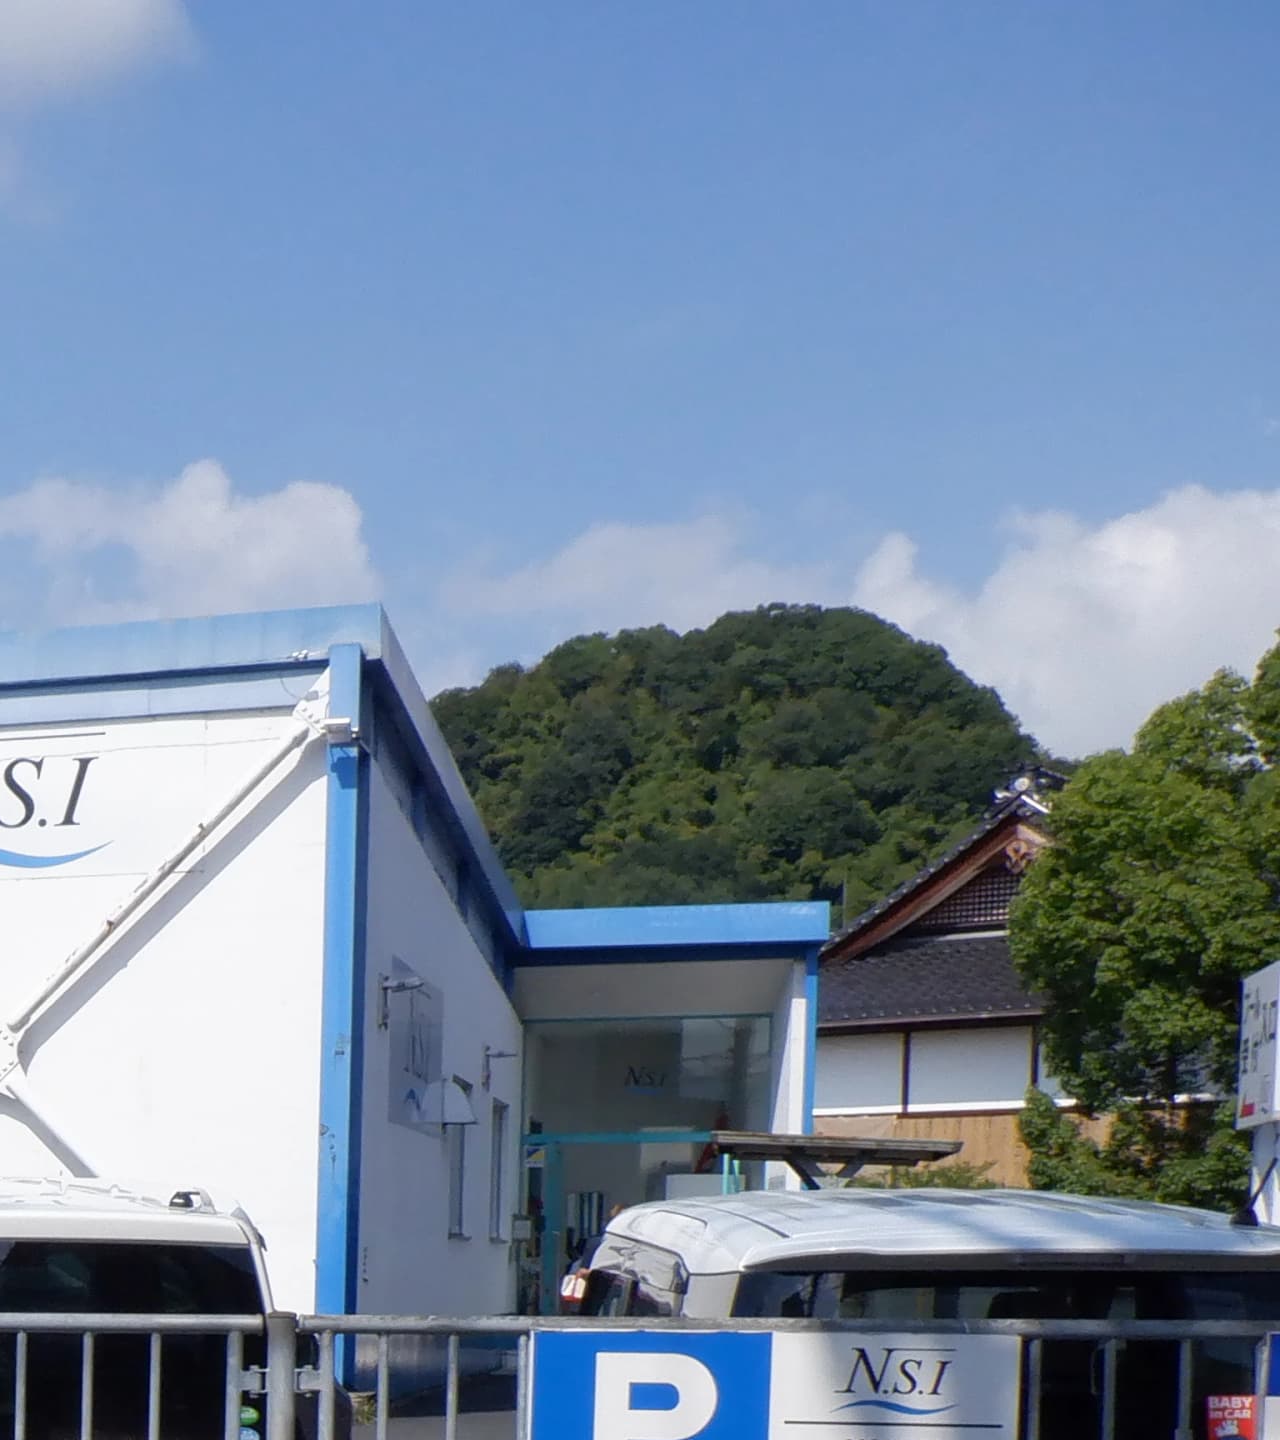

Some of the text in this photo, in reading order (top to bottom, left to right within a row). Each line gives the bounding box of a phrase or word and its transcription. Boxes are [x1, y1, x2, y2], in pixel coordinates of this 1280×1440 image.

[834, 1347, 956, 1395] N.S.I
[1208, 1396, 1252, 1408] BABY
[1224, 1409, 1251, 1419] CAR
